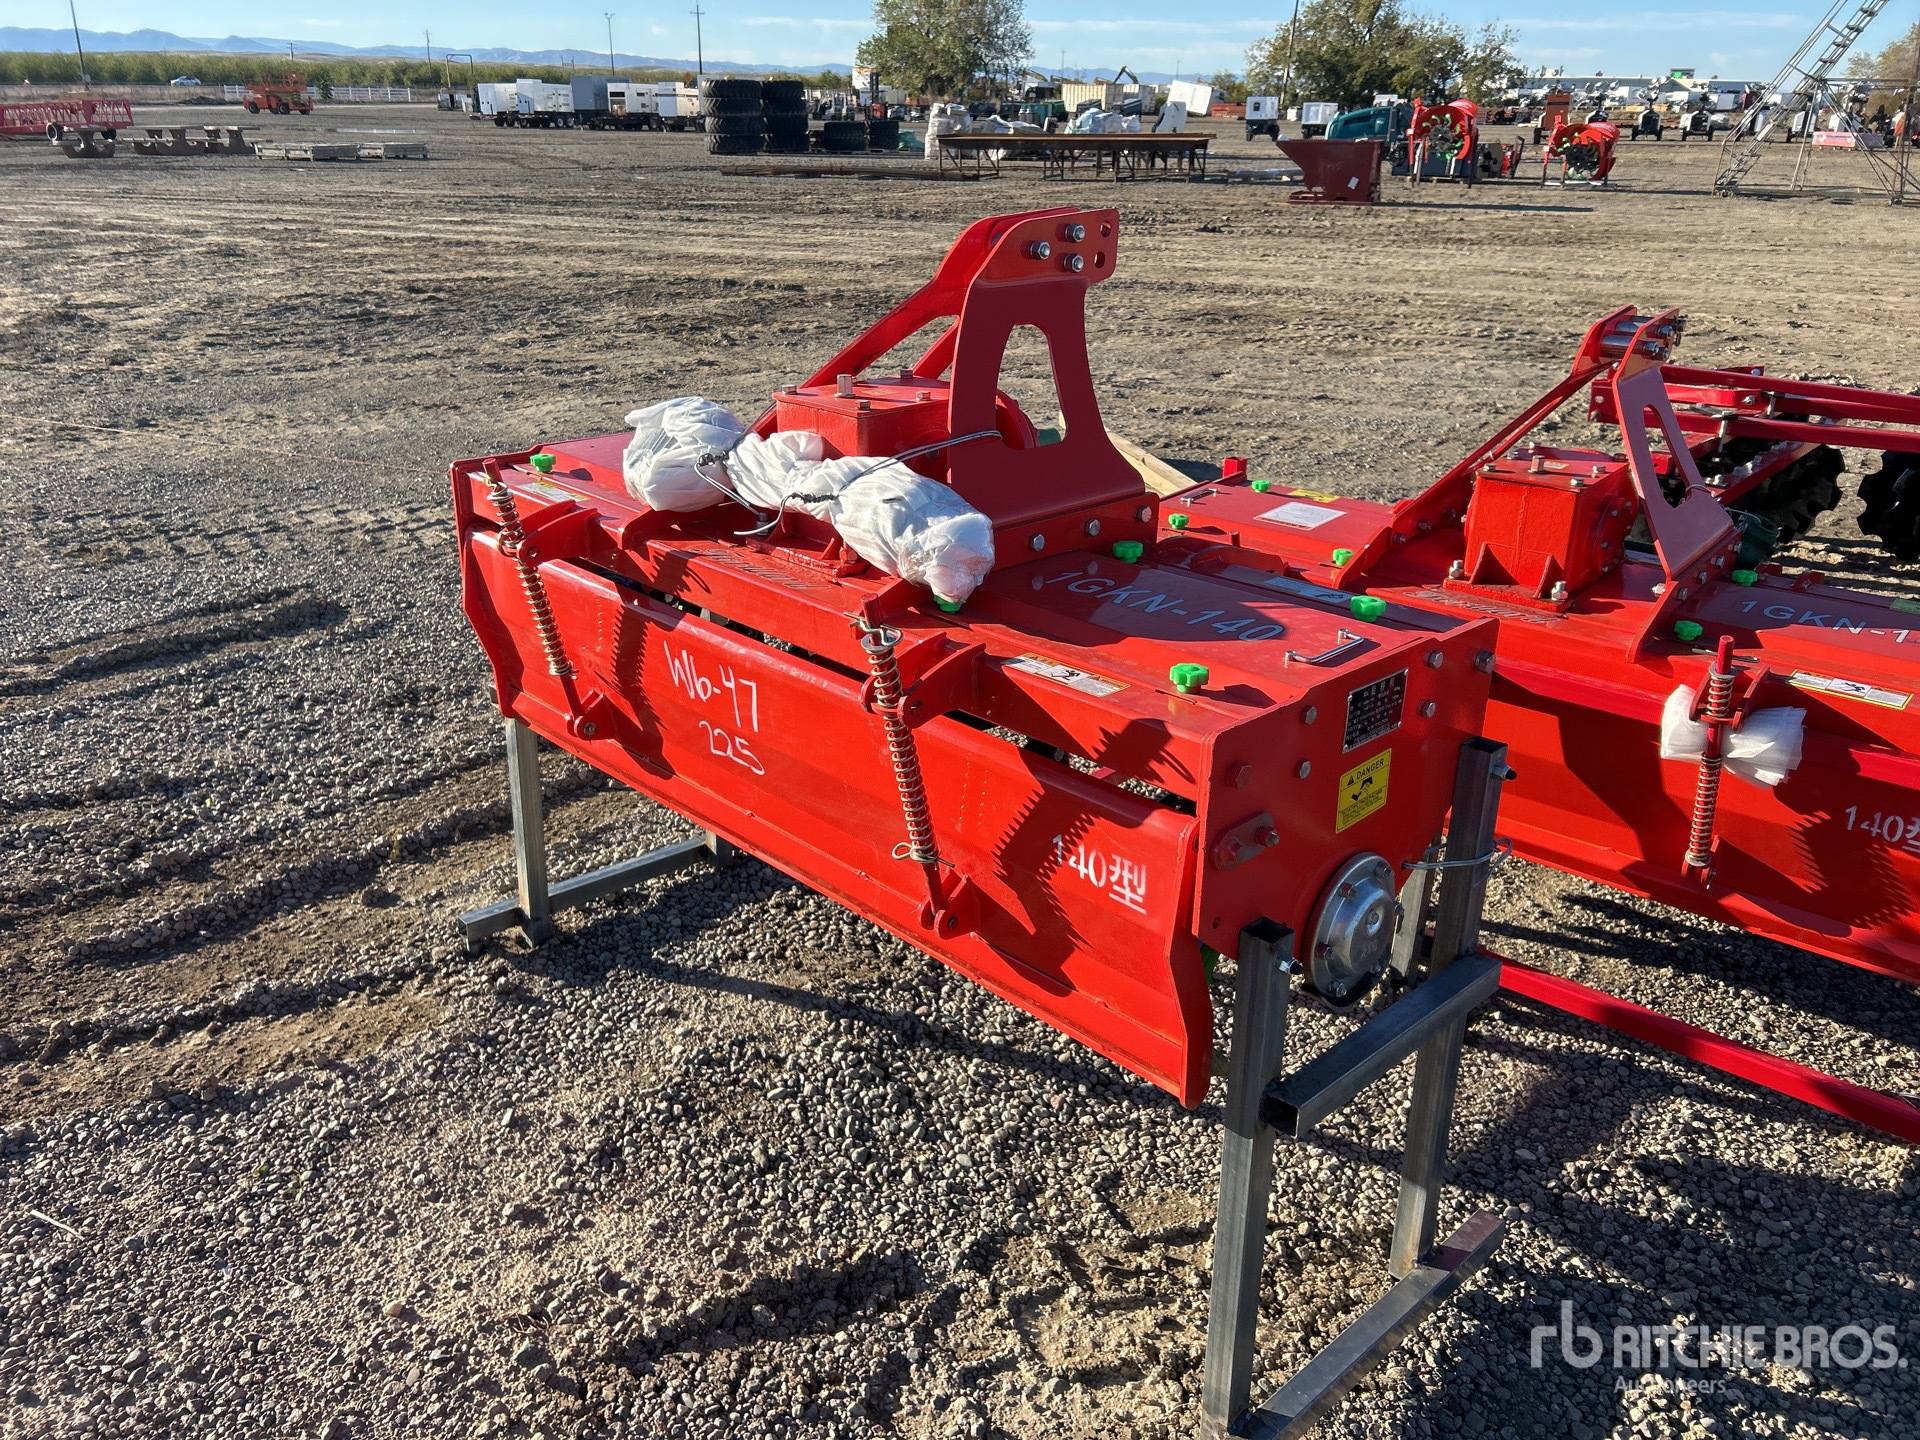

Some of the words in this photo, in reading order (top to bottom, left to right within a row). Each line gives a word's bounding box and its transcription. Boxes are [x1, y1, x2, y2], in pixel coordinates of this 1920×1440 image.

[1045, 571, 1285, 641] 1GKN-140
[698, 720, 766, 776] 225
[1356, 758, 1385, 780] DANGER
[1052, 833, 1147, 915] 140型
